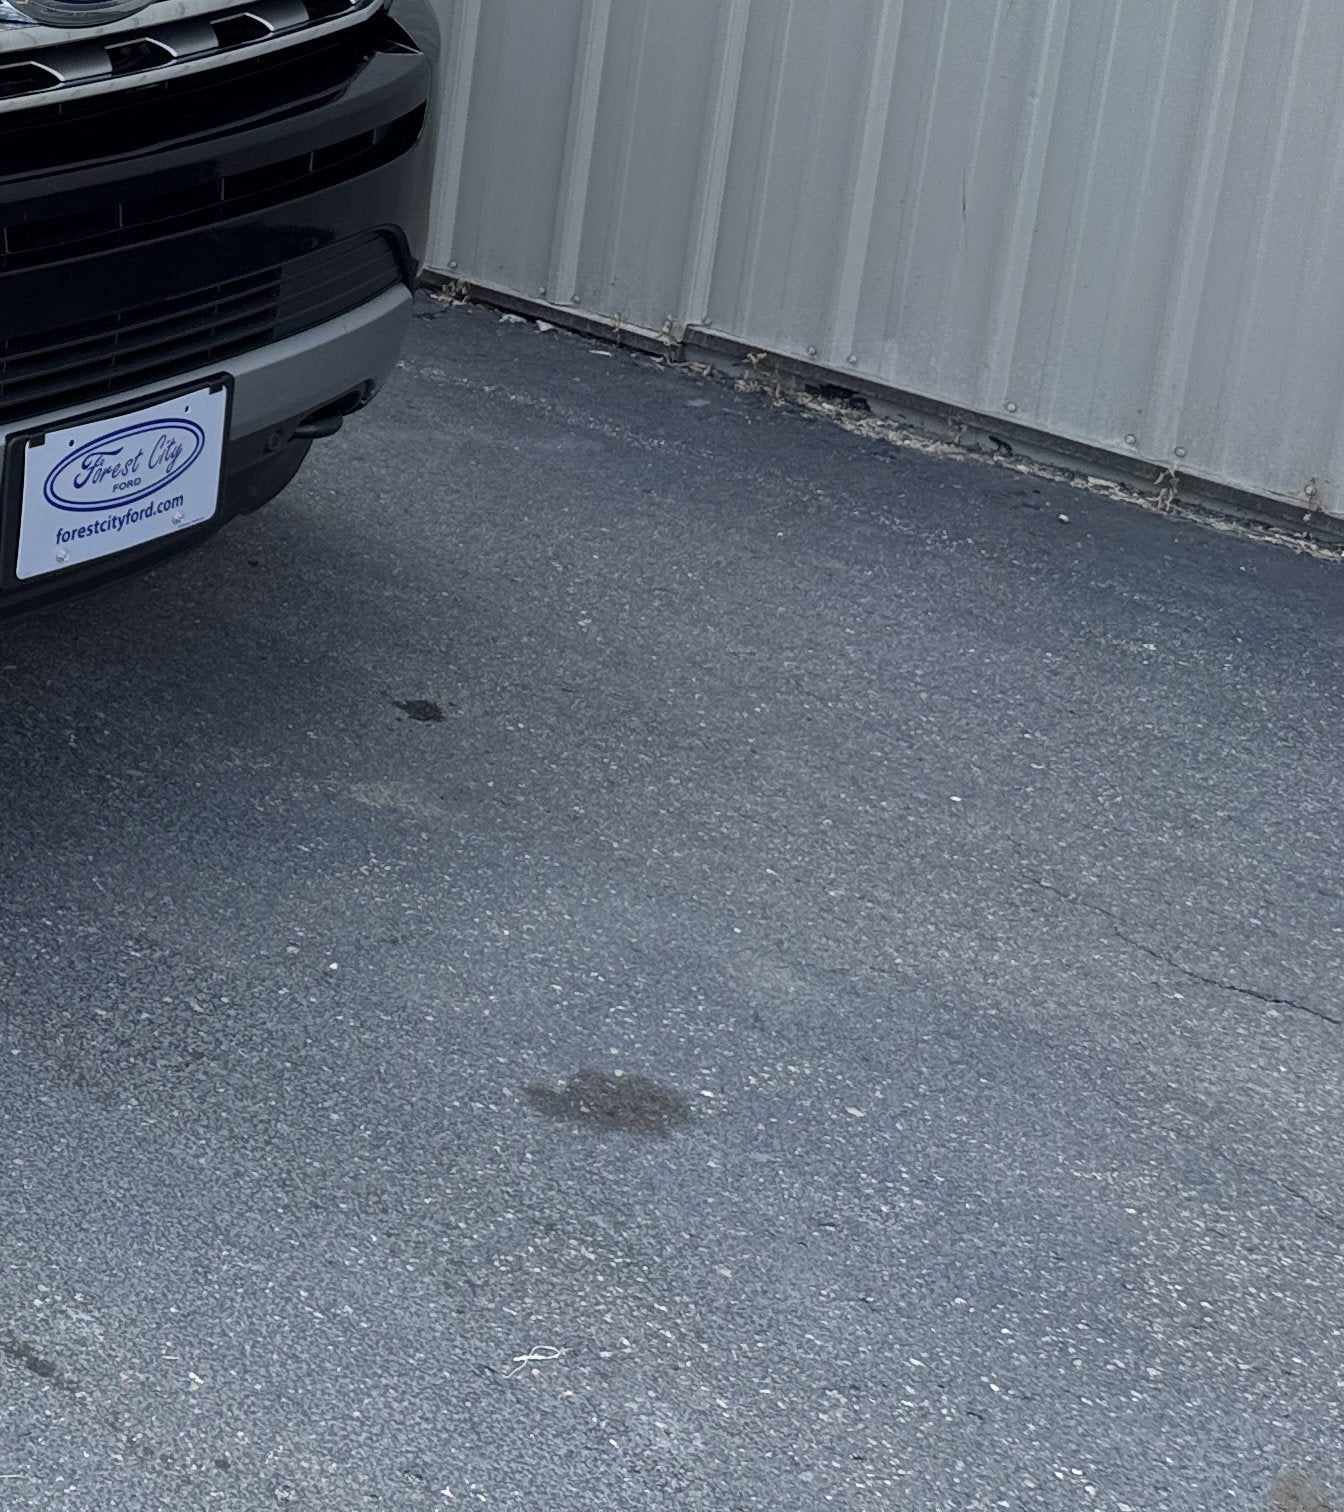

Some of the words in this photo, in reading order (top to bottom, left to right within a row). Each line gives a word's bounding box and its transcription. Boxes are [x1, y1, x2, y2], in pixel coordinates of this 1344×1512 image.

[73, 446, 143, 489] Forest
[148, 434, 183, 473] City
[112, 477, 142, 493] FORD
[56, 494, 184, 545] forestcityford.com
